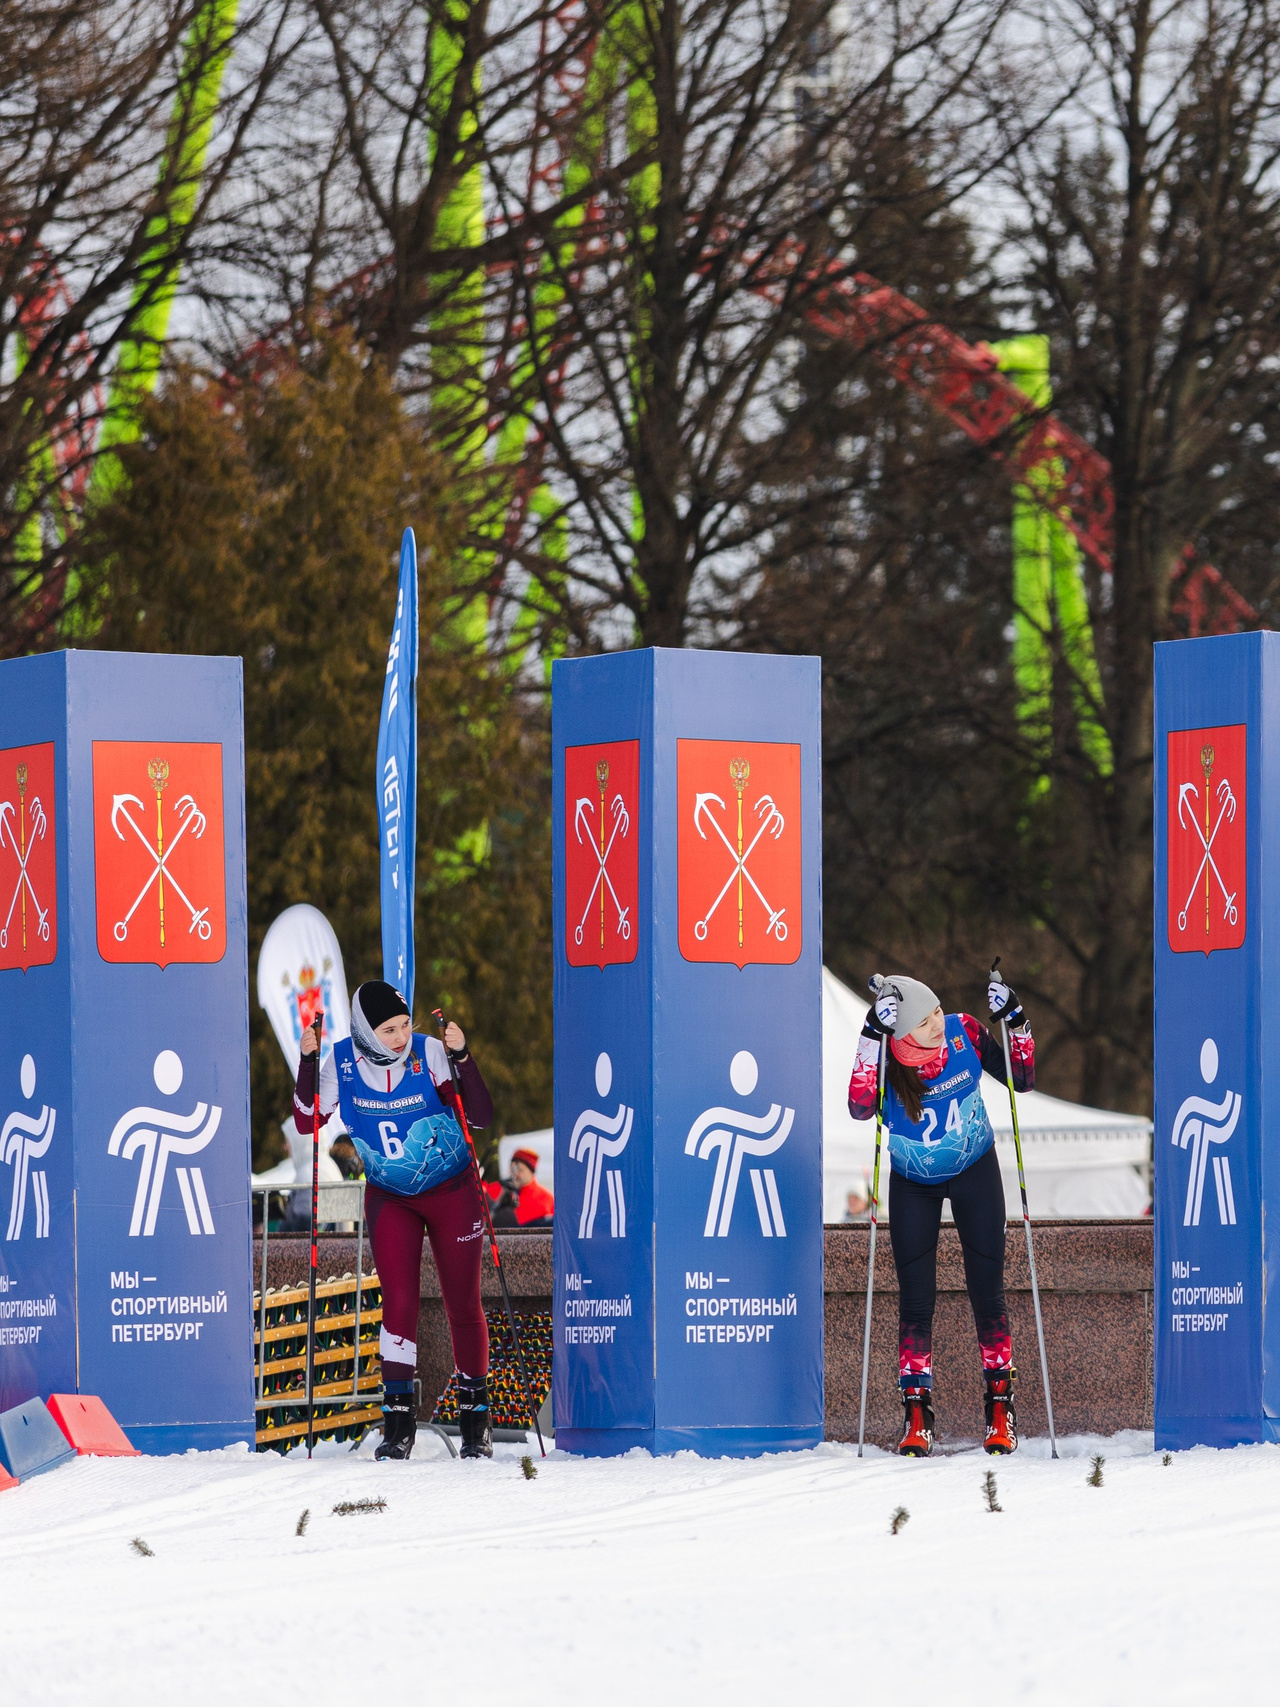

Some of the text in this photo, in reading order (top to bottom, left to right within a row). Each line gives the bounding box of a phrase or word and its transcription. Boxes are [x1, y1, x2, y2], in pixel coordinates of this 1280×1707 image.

[942, 1071, 970, 1091] ГОНКИ
[390, 1095, 423, 1109] ГОНКИ
[919, 1098, 964, 1147] 24
[378, 1120, 405, 1160] 6
[111, 1290, 228, 1316] СПОРТИВНЫЙ
[686, 1293, 797, 1316] СПОРТИВНЫЙ
[1172, 1282, 1243, 1305] СПОРТИВНЫЙ
[0, 1294, 56, 1319] ПОРТИВНЫЙ
[565, 1294, 632, 1317] СПОРТИВНЫЙ
[112, 1323, 203, 1342] ПЕТЕРБУРГ
[687, 1325, 773, 1342] ПЕТЕРБУРГ
[1173, 1314, 1228, 1331] ПЕТЕРБУРГ
[565, 1326, 616, 1344] ПЕТЕРБУРГ
